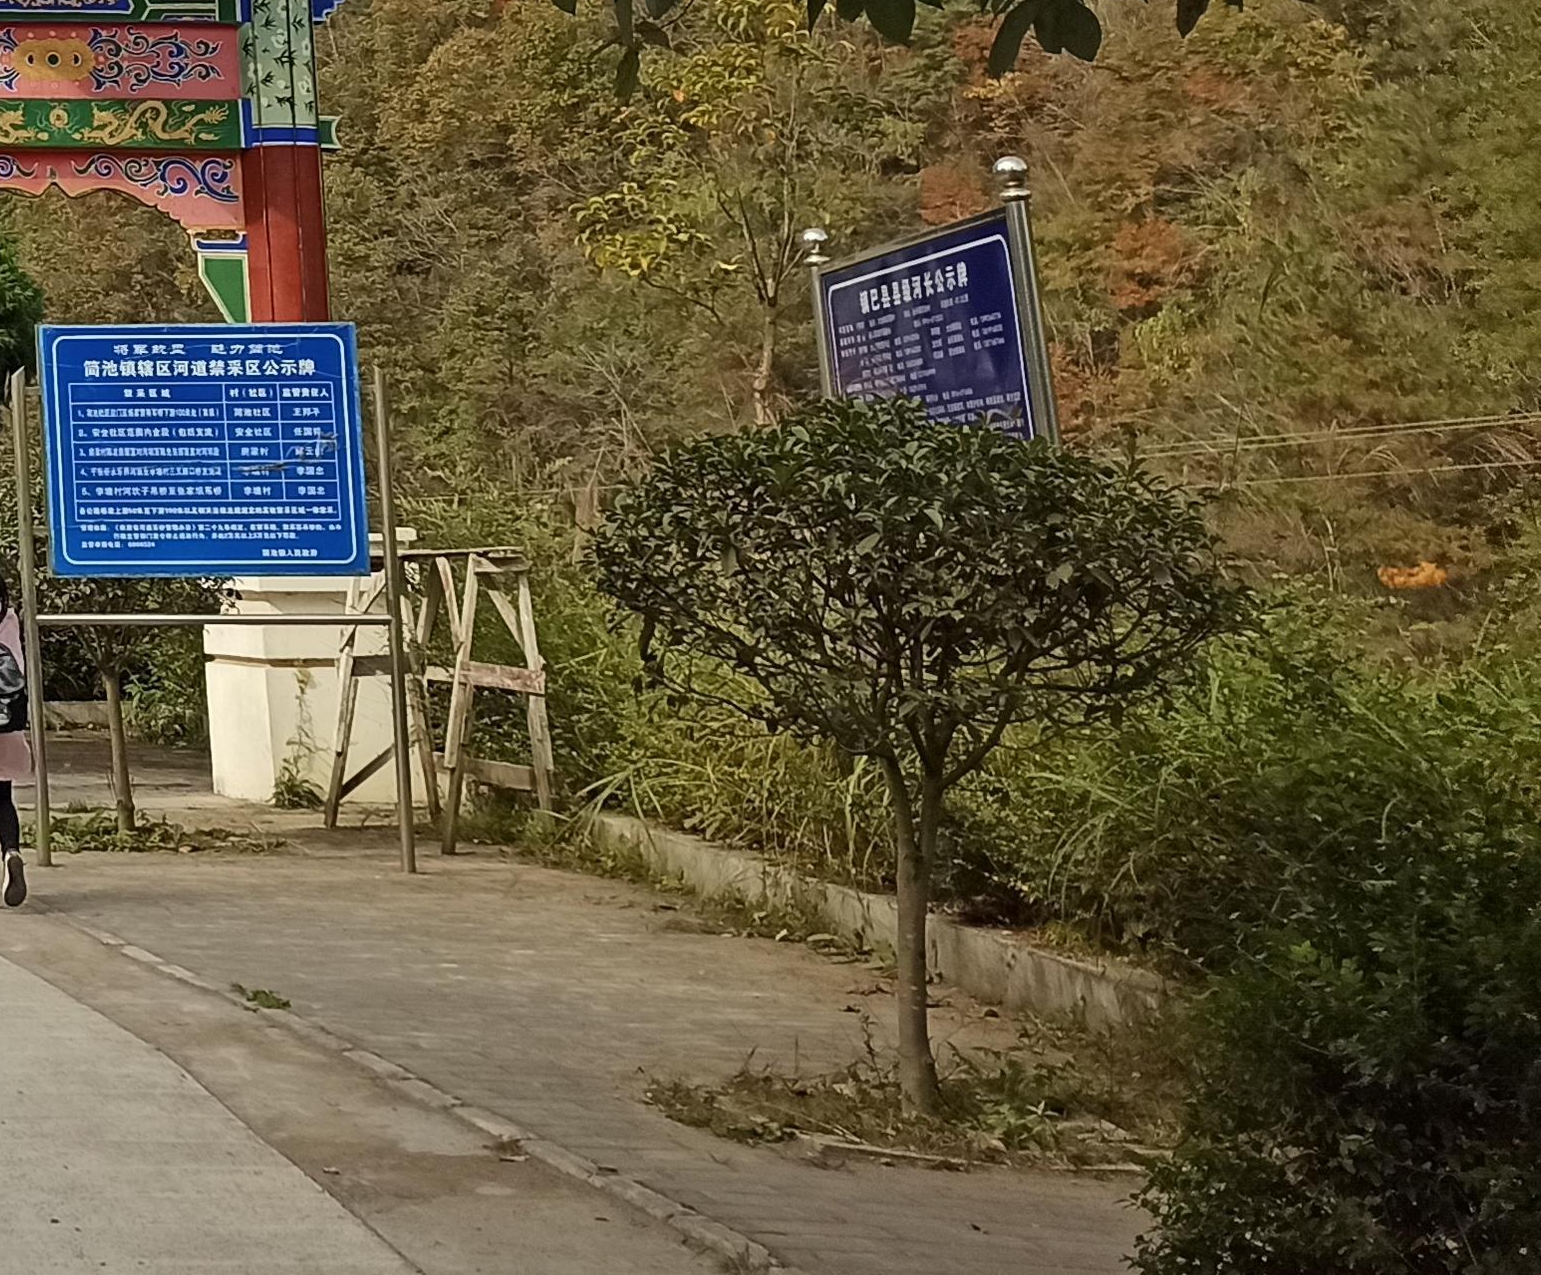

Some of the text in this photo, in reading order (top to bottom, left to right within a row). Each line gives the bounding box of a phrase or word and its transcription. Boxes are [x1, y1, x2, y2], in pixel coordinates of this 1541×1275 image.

[113, 344, 186, 355] 将军故里
[83, 358, 316, 378] 简池镇辖区河道禁采区公示牌
